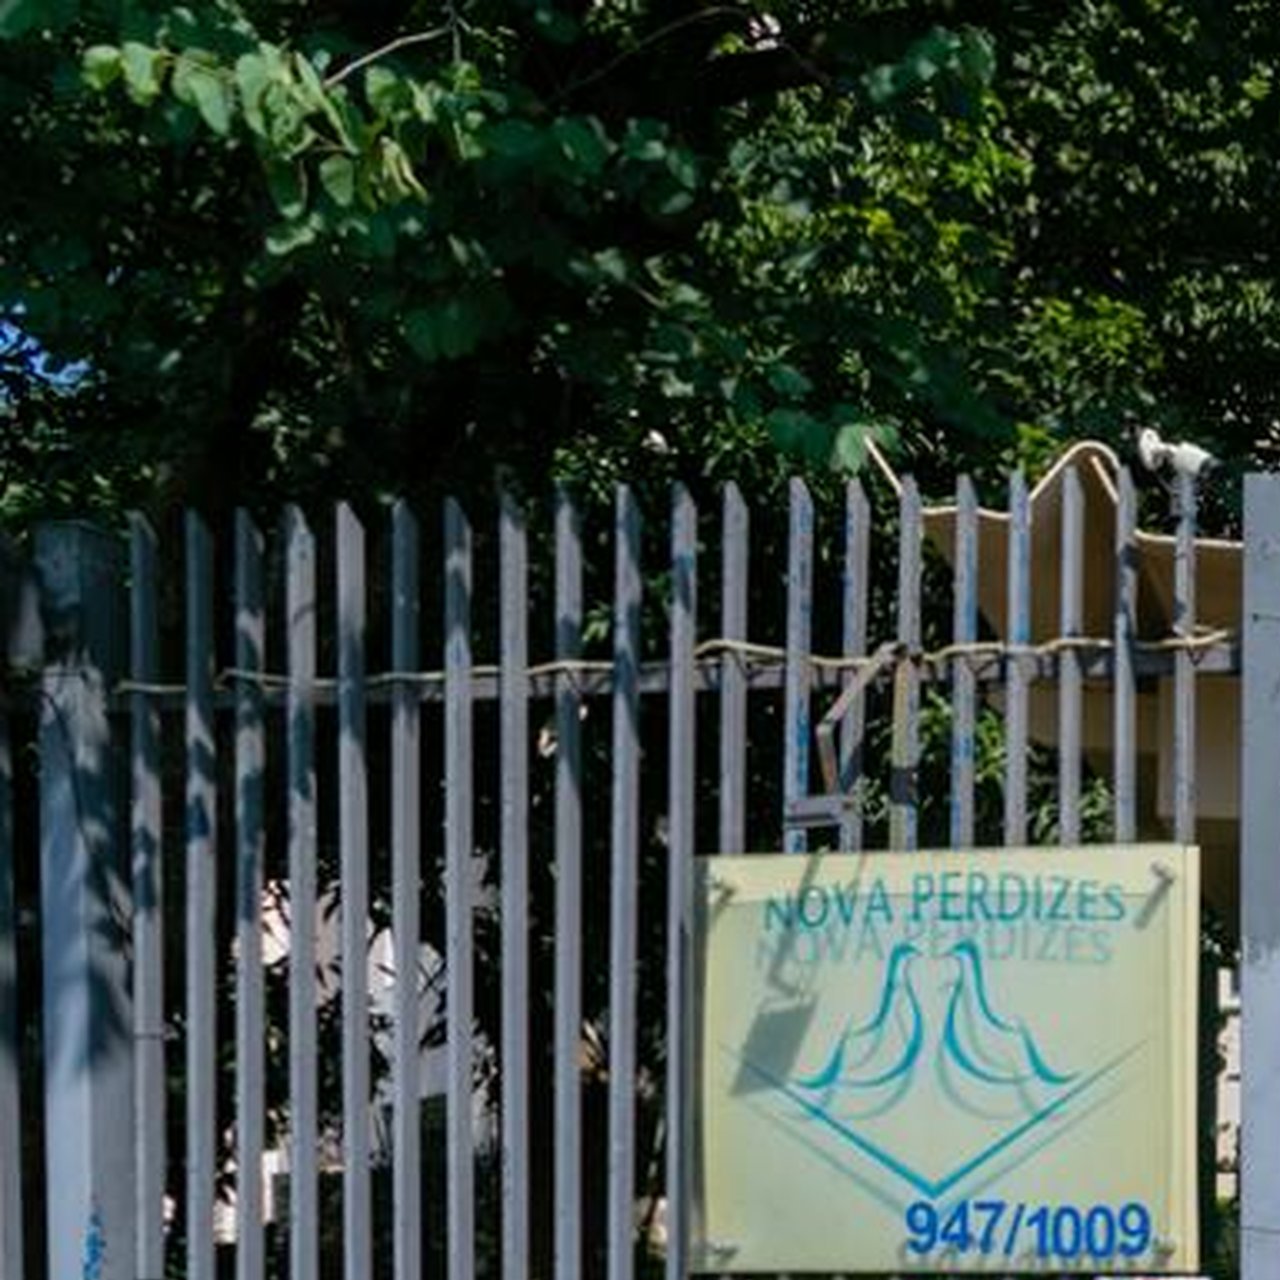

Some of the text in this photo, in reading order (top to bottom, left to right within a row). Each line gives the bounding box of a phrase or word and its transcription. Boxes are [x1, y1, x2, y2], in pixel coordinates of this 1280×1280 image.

[764, 871, 1126, 930] NOVA PERDIZES
[905, 1200, 1150, 1259] 947/1009
